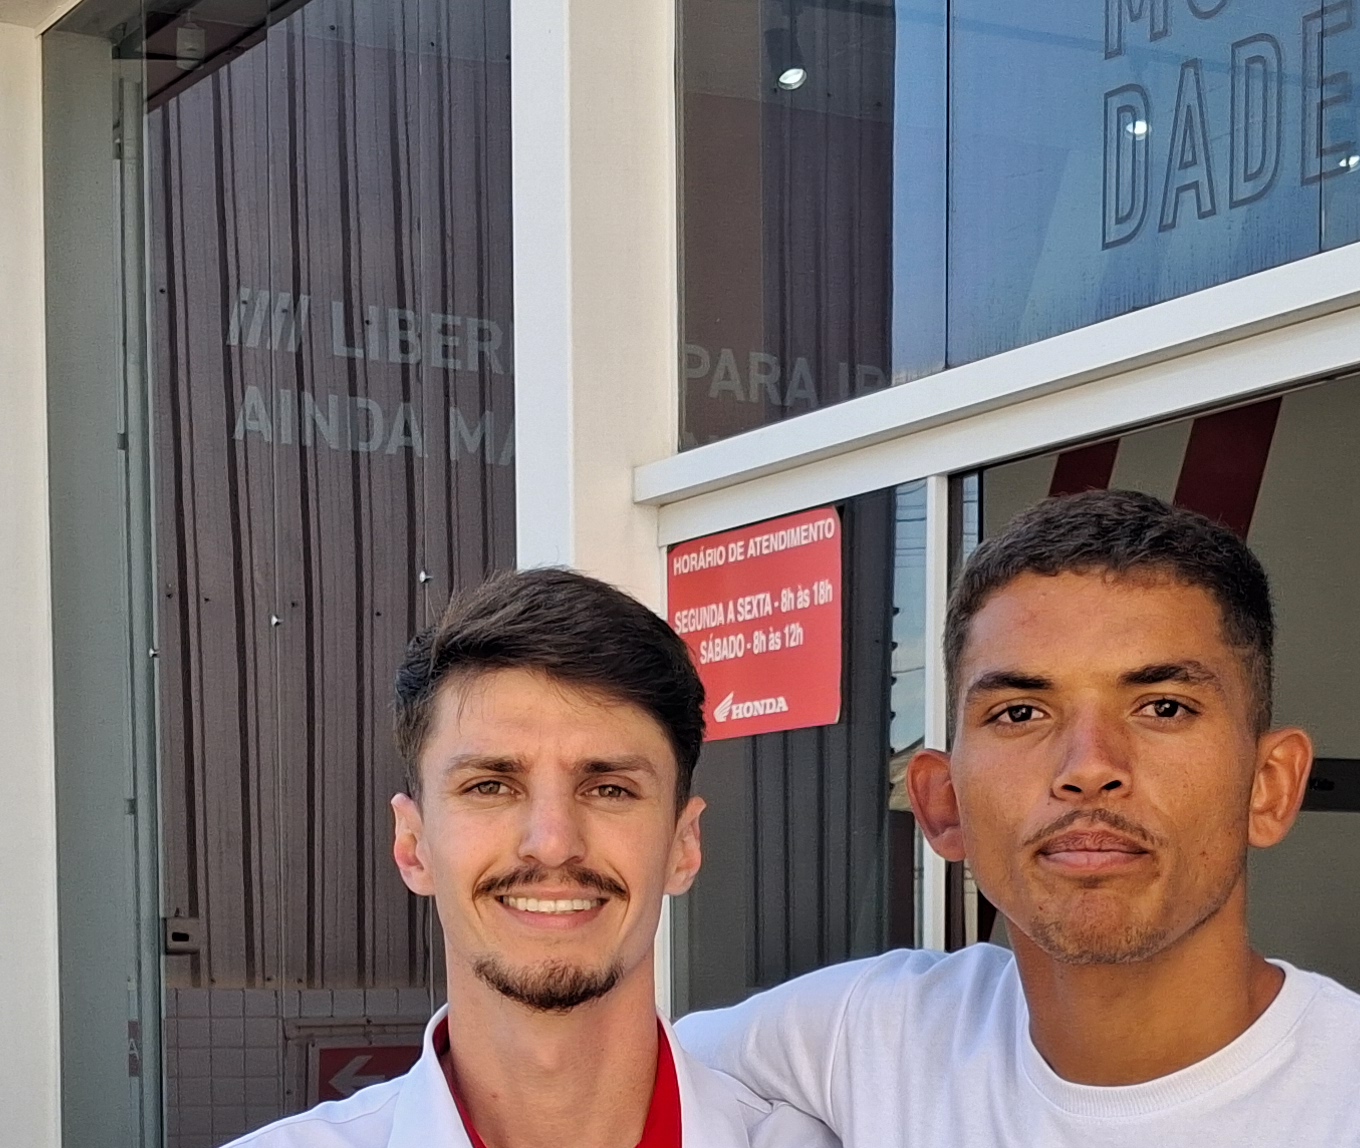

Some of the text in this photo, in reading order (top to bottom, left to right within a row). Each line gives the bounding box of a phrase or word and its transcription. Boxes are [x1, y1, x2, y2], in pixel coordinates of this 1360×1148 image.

[1101, 0, 1356, 250] DADE
[331, 300, 514, 376] LIBER
[683, 343, 820, 410] PARA
[232, 385, 428, 459] AINDA
[673, 517, 835, 576] HORÁRIO DE ATENDIMENTO
[674, 602, 725, 636] SEGUNDA
[727, 601, 735, 623] A
[737, 592, 772, 623] SEXTA
[780, 587, 794, 613] 8h
[797, 584, 810, 610] às
[813, 579, 833, 606] 18h
[700, 632, 744, 665] SÁBADO
[753, 630, 766, 655] 8h
[768, 626, 781, 651] às
[784, 622, 804, 648] 12h
[731, 696, 788, 720] HONDA
